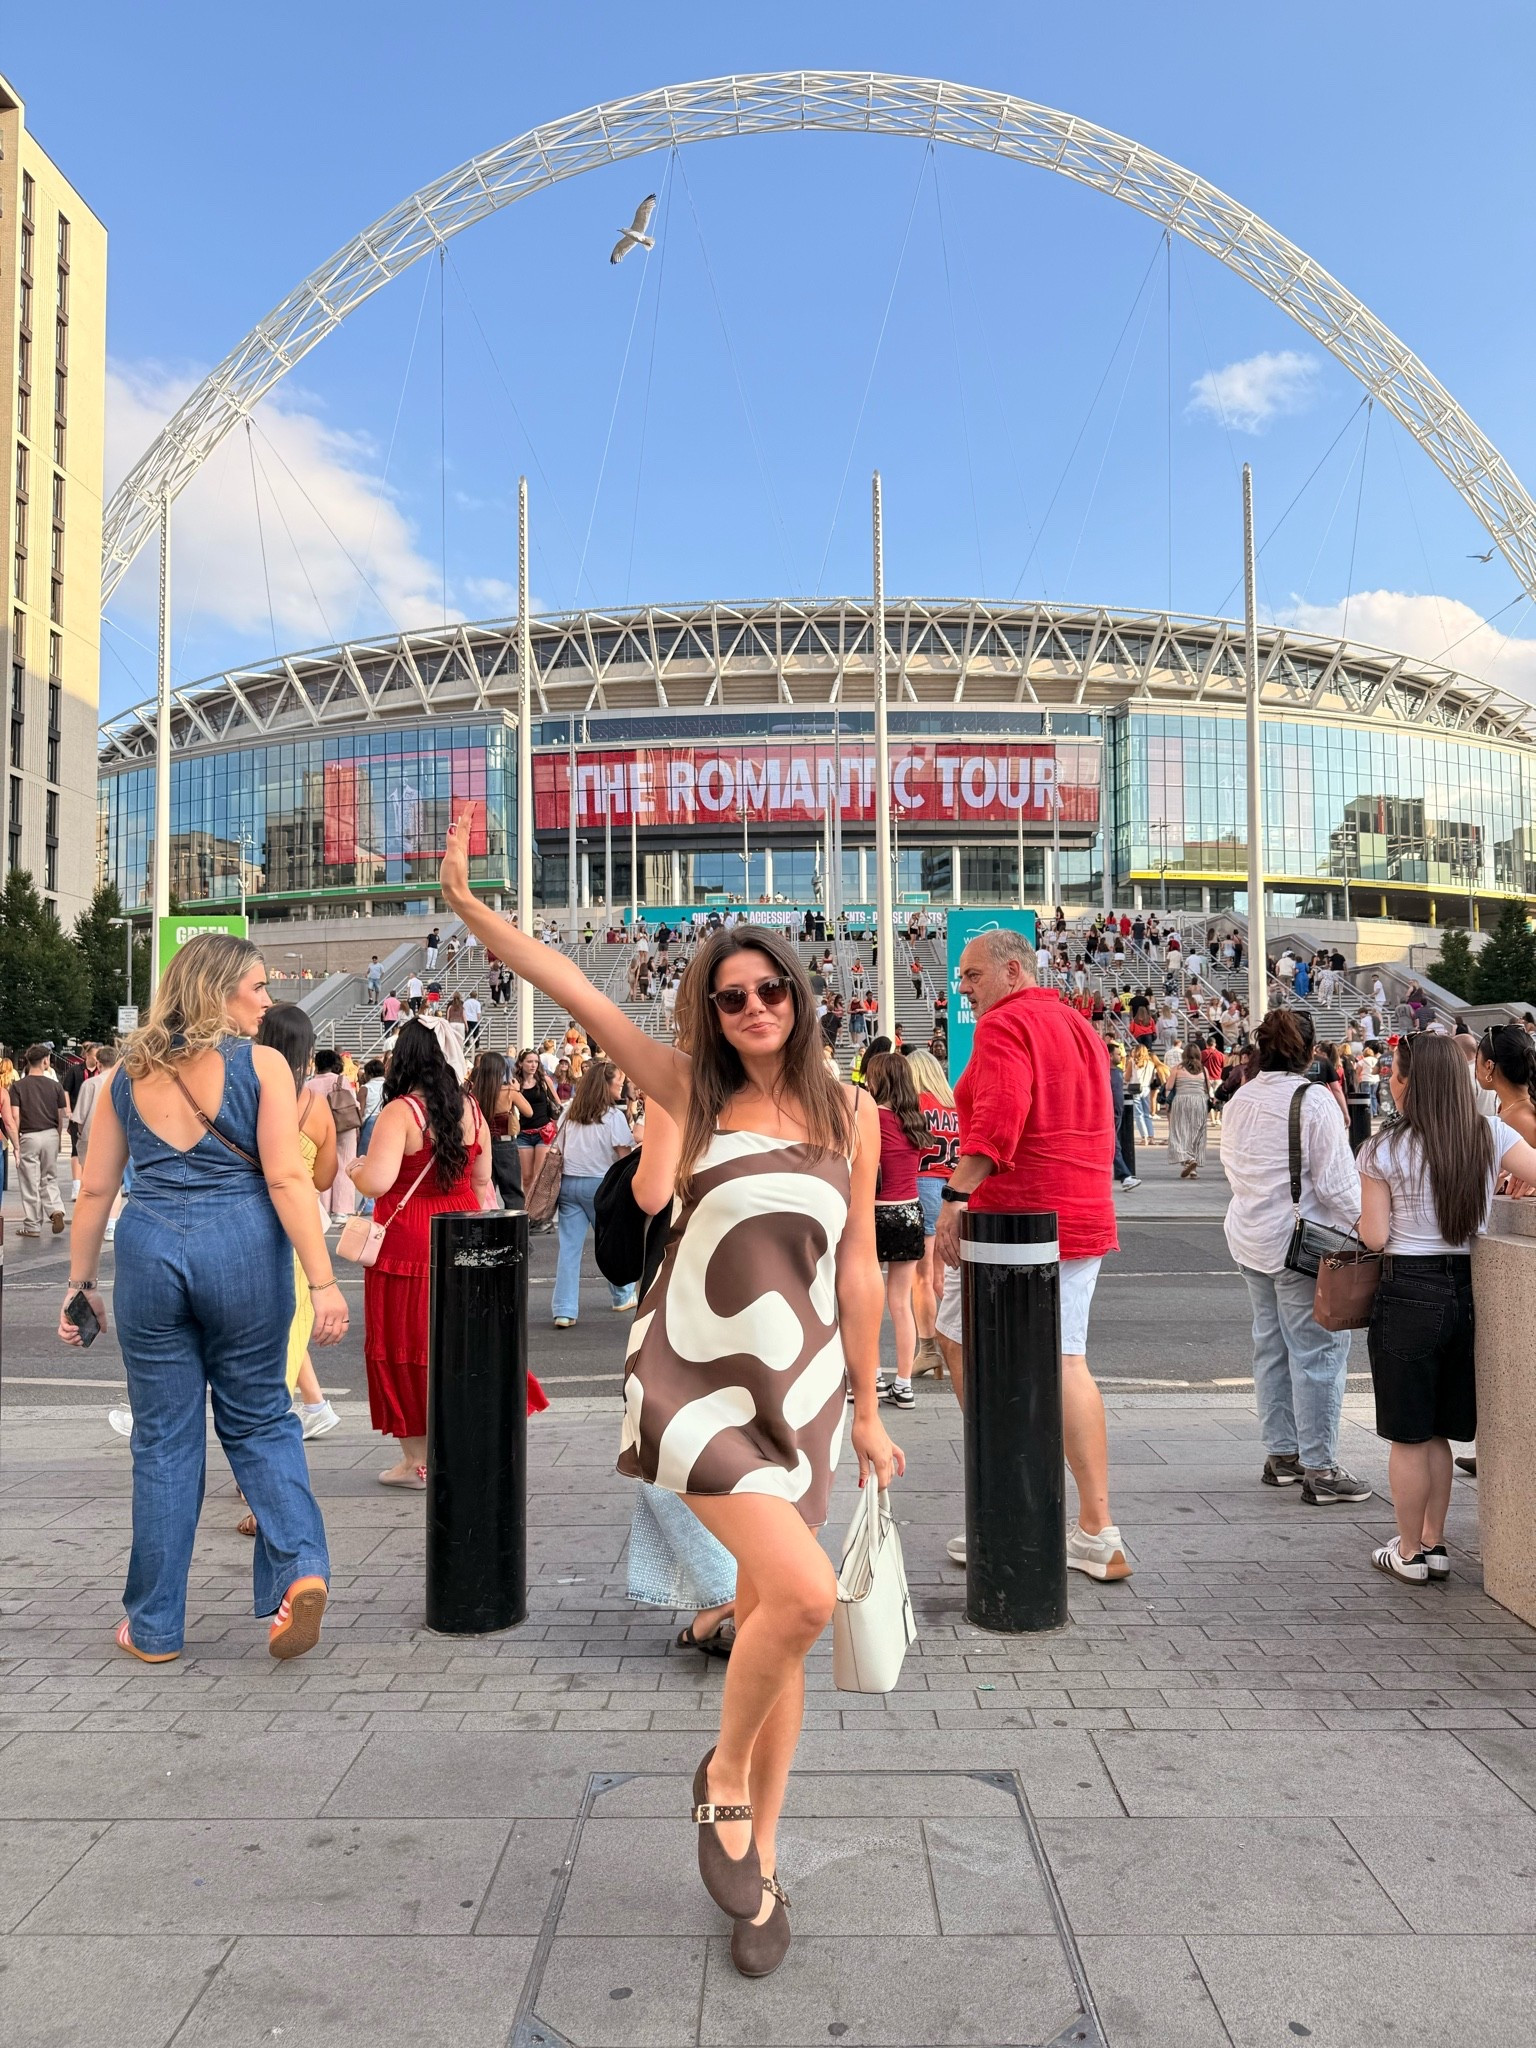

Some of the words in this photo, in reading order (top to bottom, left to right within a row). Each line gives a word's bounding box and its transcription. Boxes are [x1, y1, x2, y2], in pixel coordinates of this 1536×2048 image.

[566, 763, 656, 815] THE
[667, 757, 926, 811] ROMANTC
[933, 756, 1064, 809] TOUR
[750, 911, 799, 924] ACCESSIB
[924, 1108, 960, 1132] MAR
